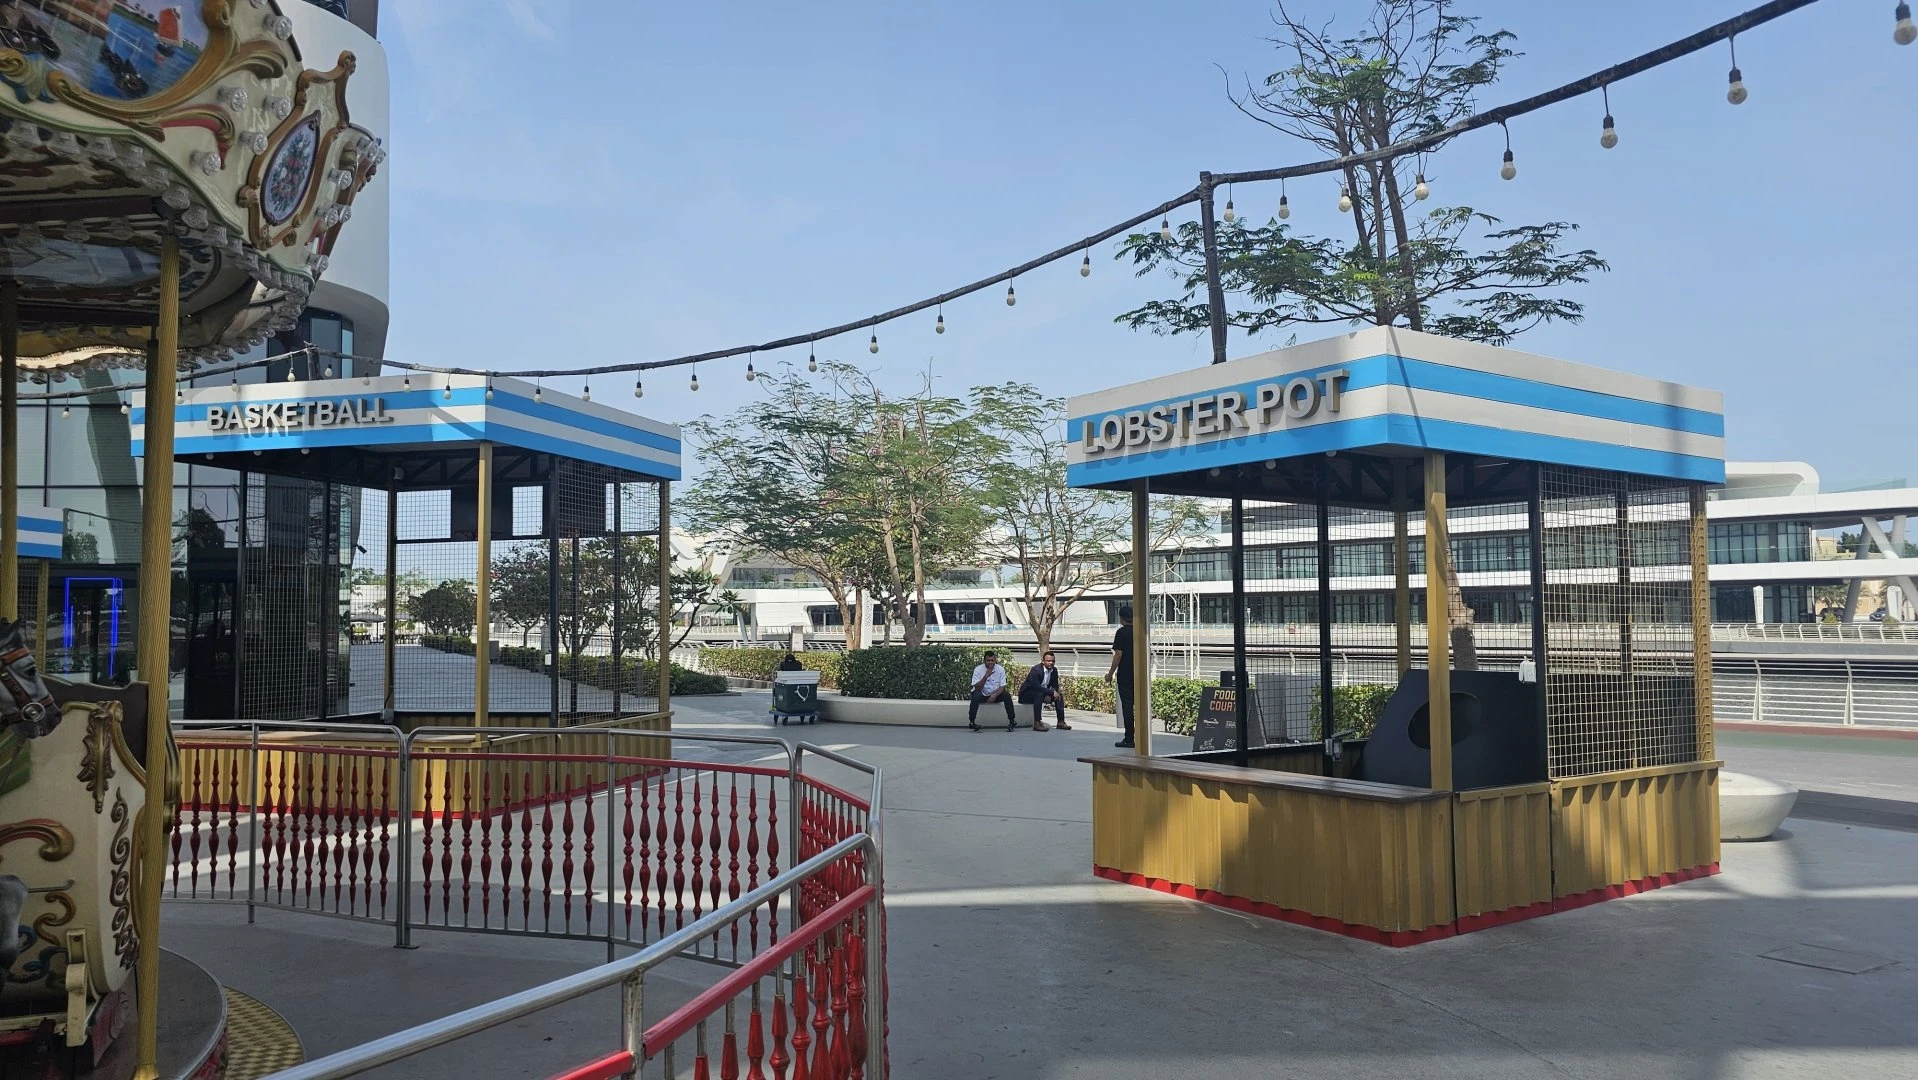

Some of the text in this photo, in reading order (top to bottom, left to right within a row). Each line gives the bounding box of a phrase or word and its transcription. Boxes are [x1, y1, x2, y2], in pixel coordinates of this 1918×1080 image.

[207, 397, 393, 430] BASKETBALL
[1082, 368, 1350, 454] LOBSTER POT
[1213, 690, 1236, 700] FOOD
